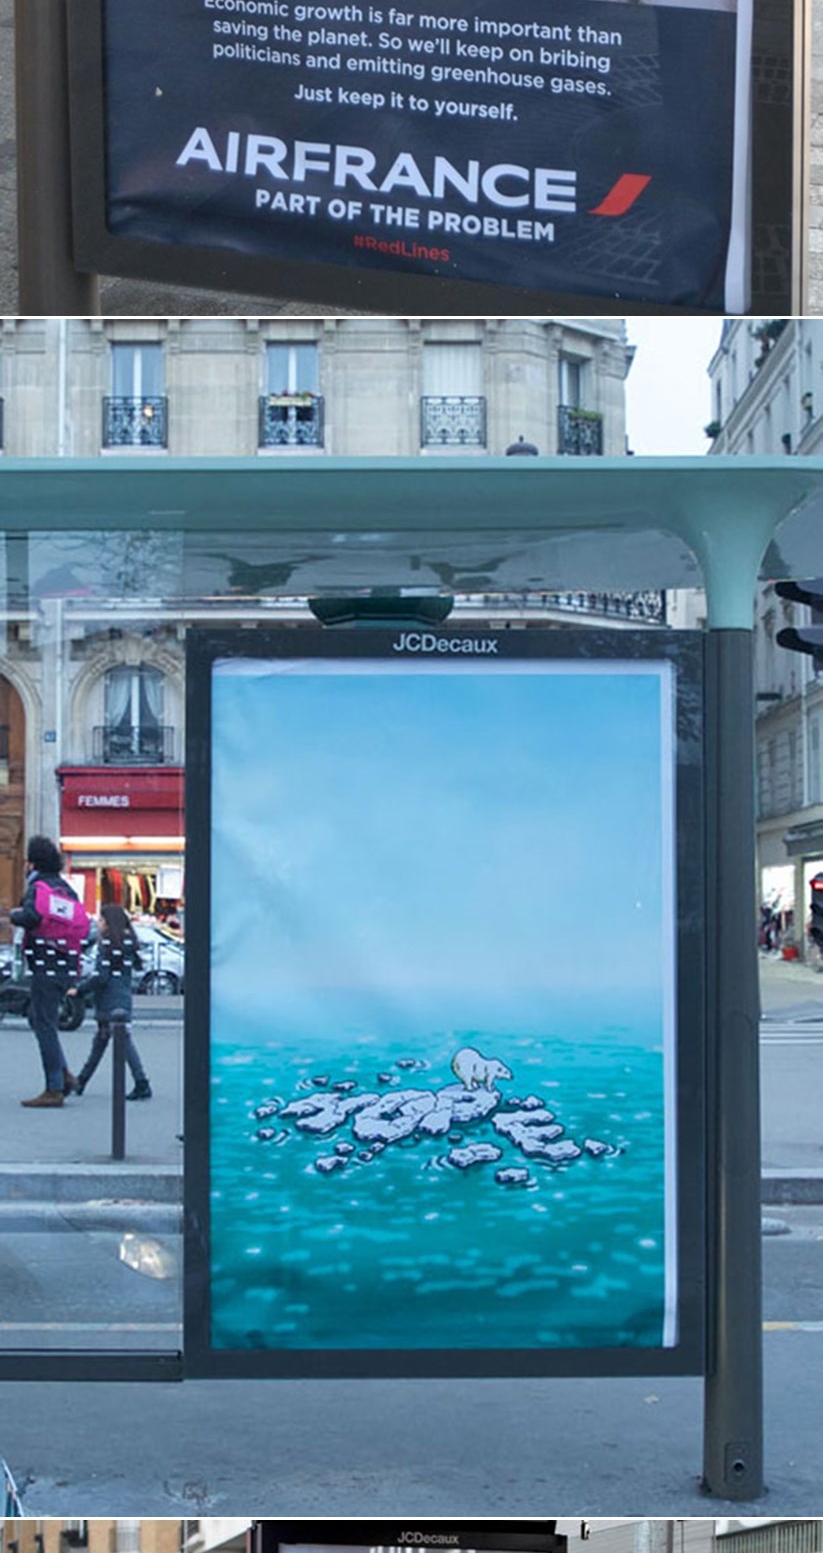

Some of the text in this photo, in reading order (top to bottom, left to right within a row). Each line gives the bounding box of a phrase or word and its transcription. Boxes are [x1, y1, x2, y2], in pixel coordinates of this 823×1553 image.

[294, 4, 363, 22] growth
[368, 7, 383, 23] is
[389, 7, 414, 27] far
[419, 13, 468, 32] more
[474, 16, 572, 42] important
[577, 26, 622, 46] than
[213, 19, 610, 74] saving the planet. So we'll keep on bribing
[213, 43, 612, 96] politicians and emitting greenhouse gases.
[294, 83, 518, 121] Just keep it to yourself.
[175, 126, 577, 213] AIRFRANCE
[255, 188, 555, 242] PART OF THE PROBLEM
[353, 234, 450, 262] #RedLines
[393, 633, 498, 653] JCDecaux
[78, 795, 129, 807] FEMMES
[397, 1531, 460, 1546] JCDecaux
